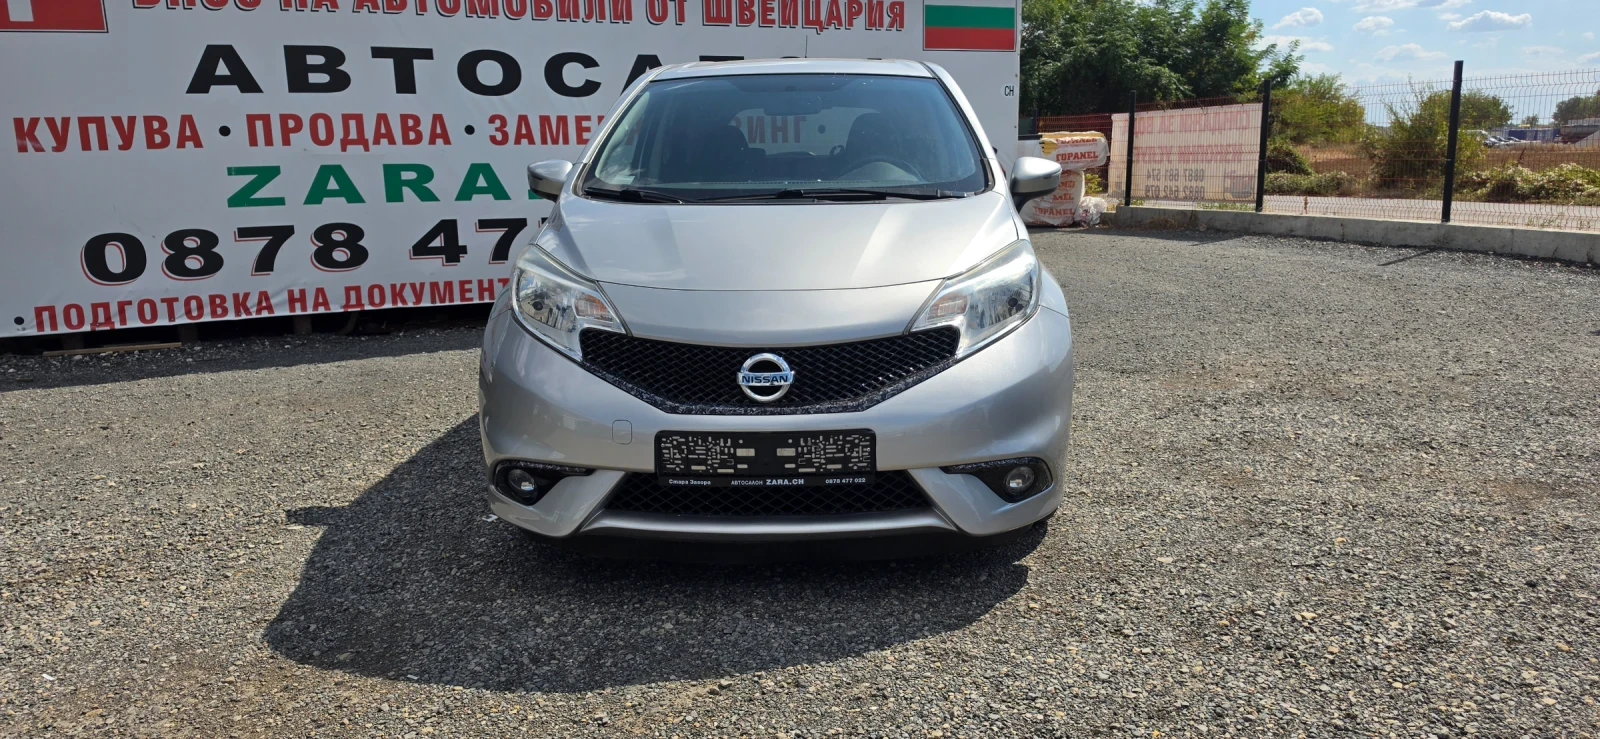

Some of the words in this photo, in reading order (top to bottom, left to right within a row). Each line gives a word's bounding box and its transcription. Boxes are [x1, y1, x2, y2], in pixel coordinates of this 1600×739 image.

[646, 0, 688, 25] ОТ
[185, 45, 882, 98] АВТОСА
[1004, 85, 1015, 97] CH
[13, 114, 204, 153] КУПУВА
[246, 112, 452, 152] ПРОДАВА
[488, 114, 643, 147] ЗАМЕ
[80, 223, 369, 286] 0878
[409, 217, 548, 267] 47
[34, 290, 275, 333] ПОДГОТОВКА
[287, 287, 331, 314] НА
[741, 375, 788, 384] NISSAN
